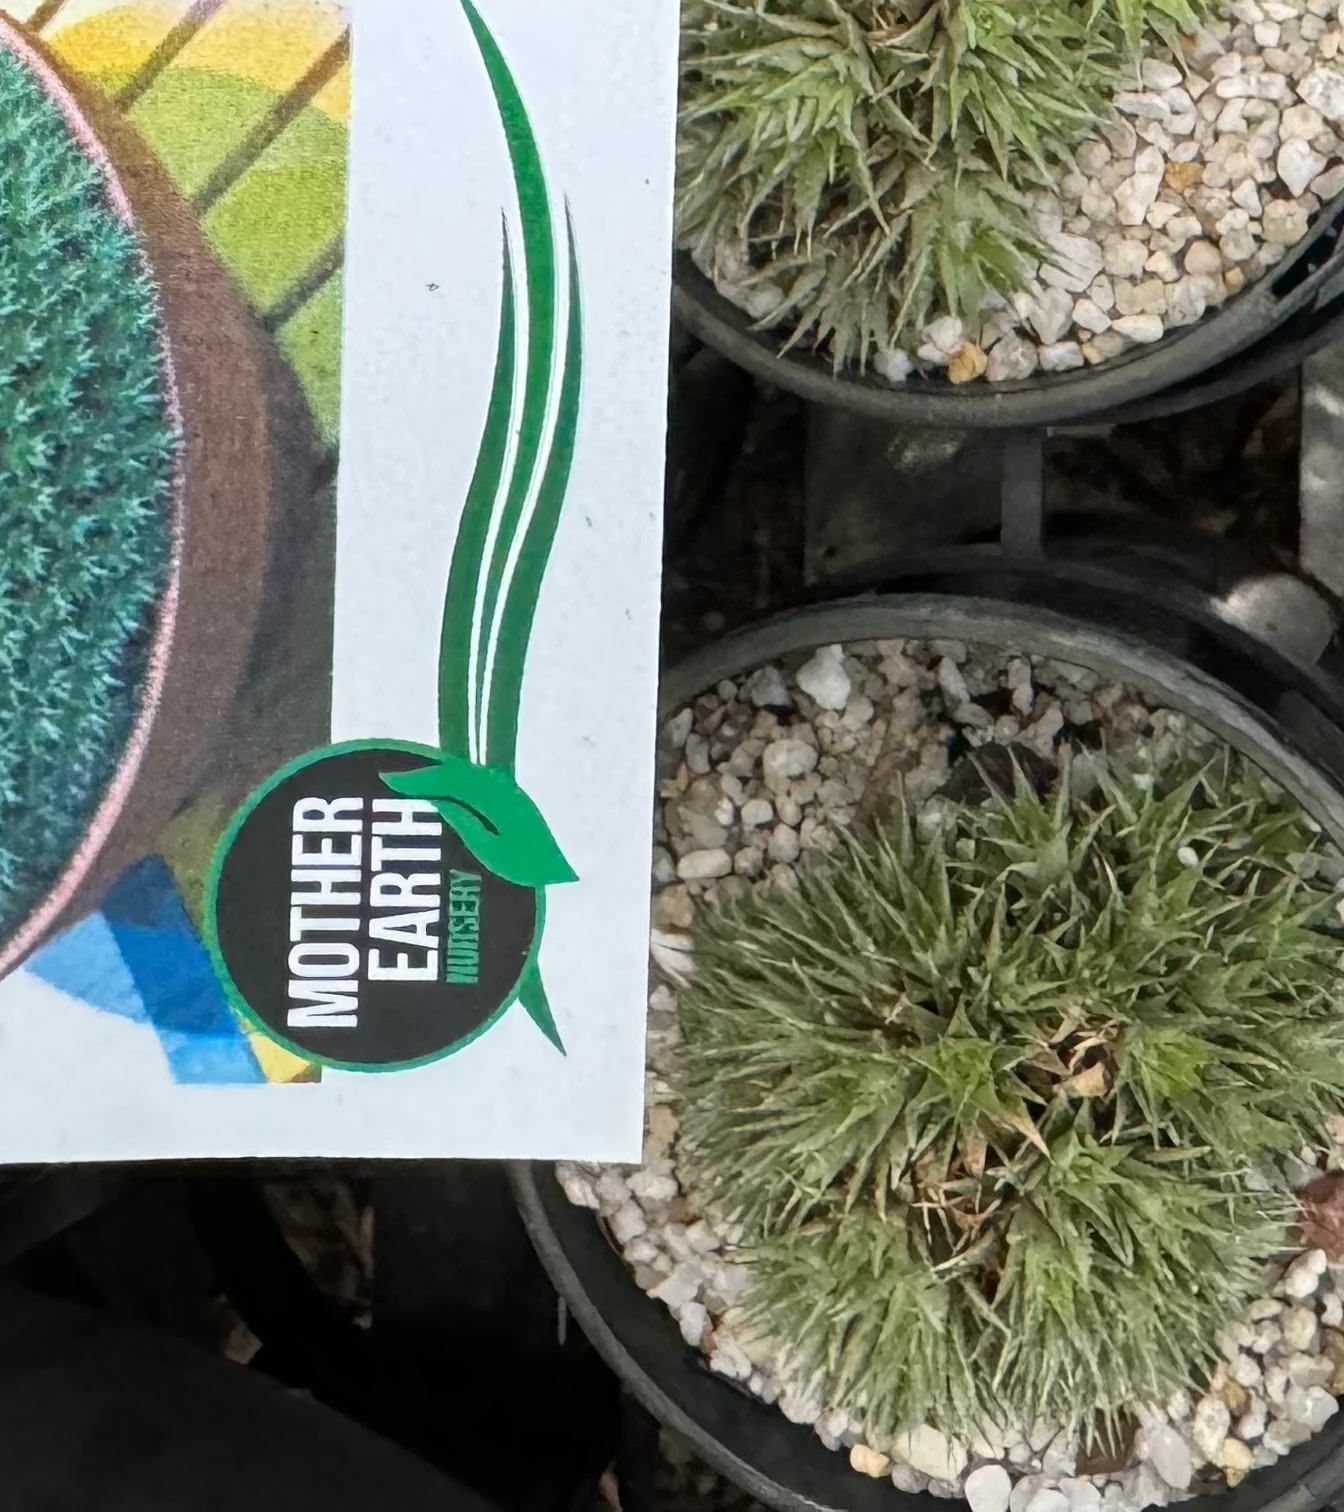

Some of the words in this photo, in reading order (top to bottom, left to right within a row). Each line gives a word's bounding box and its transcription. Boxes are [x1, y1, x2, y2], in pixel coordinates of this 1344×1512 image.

[288, 798, 363, 1028] MOTHER
[369, 800, 442, 981] EARTH
[447, 870, 481, 984] NURSERY
